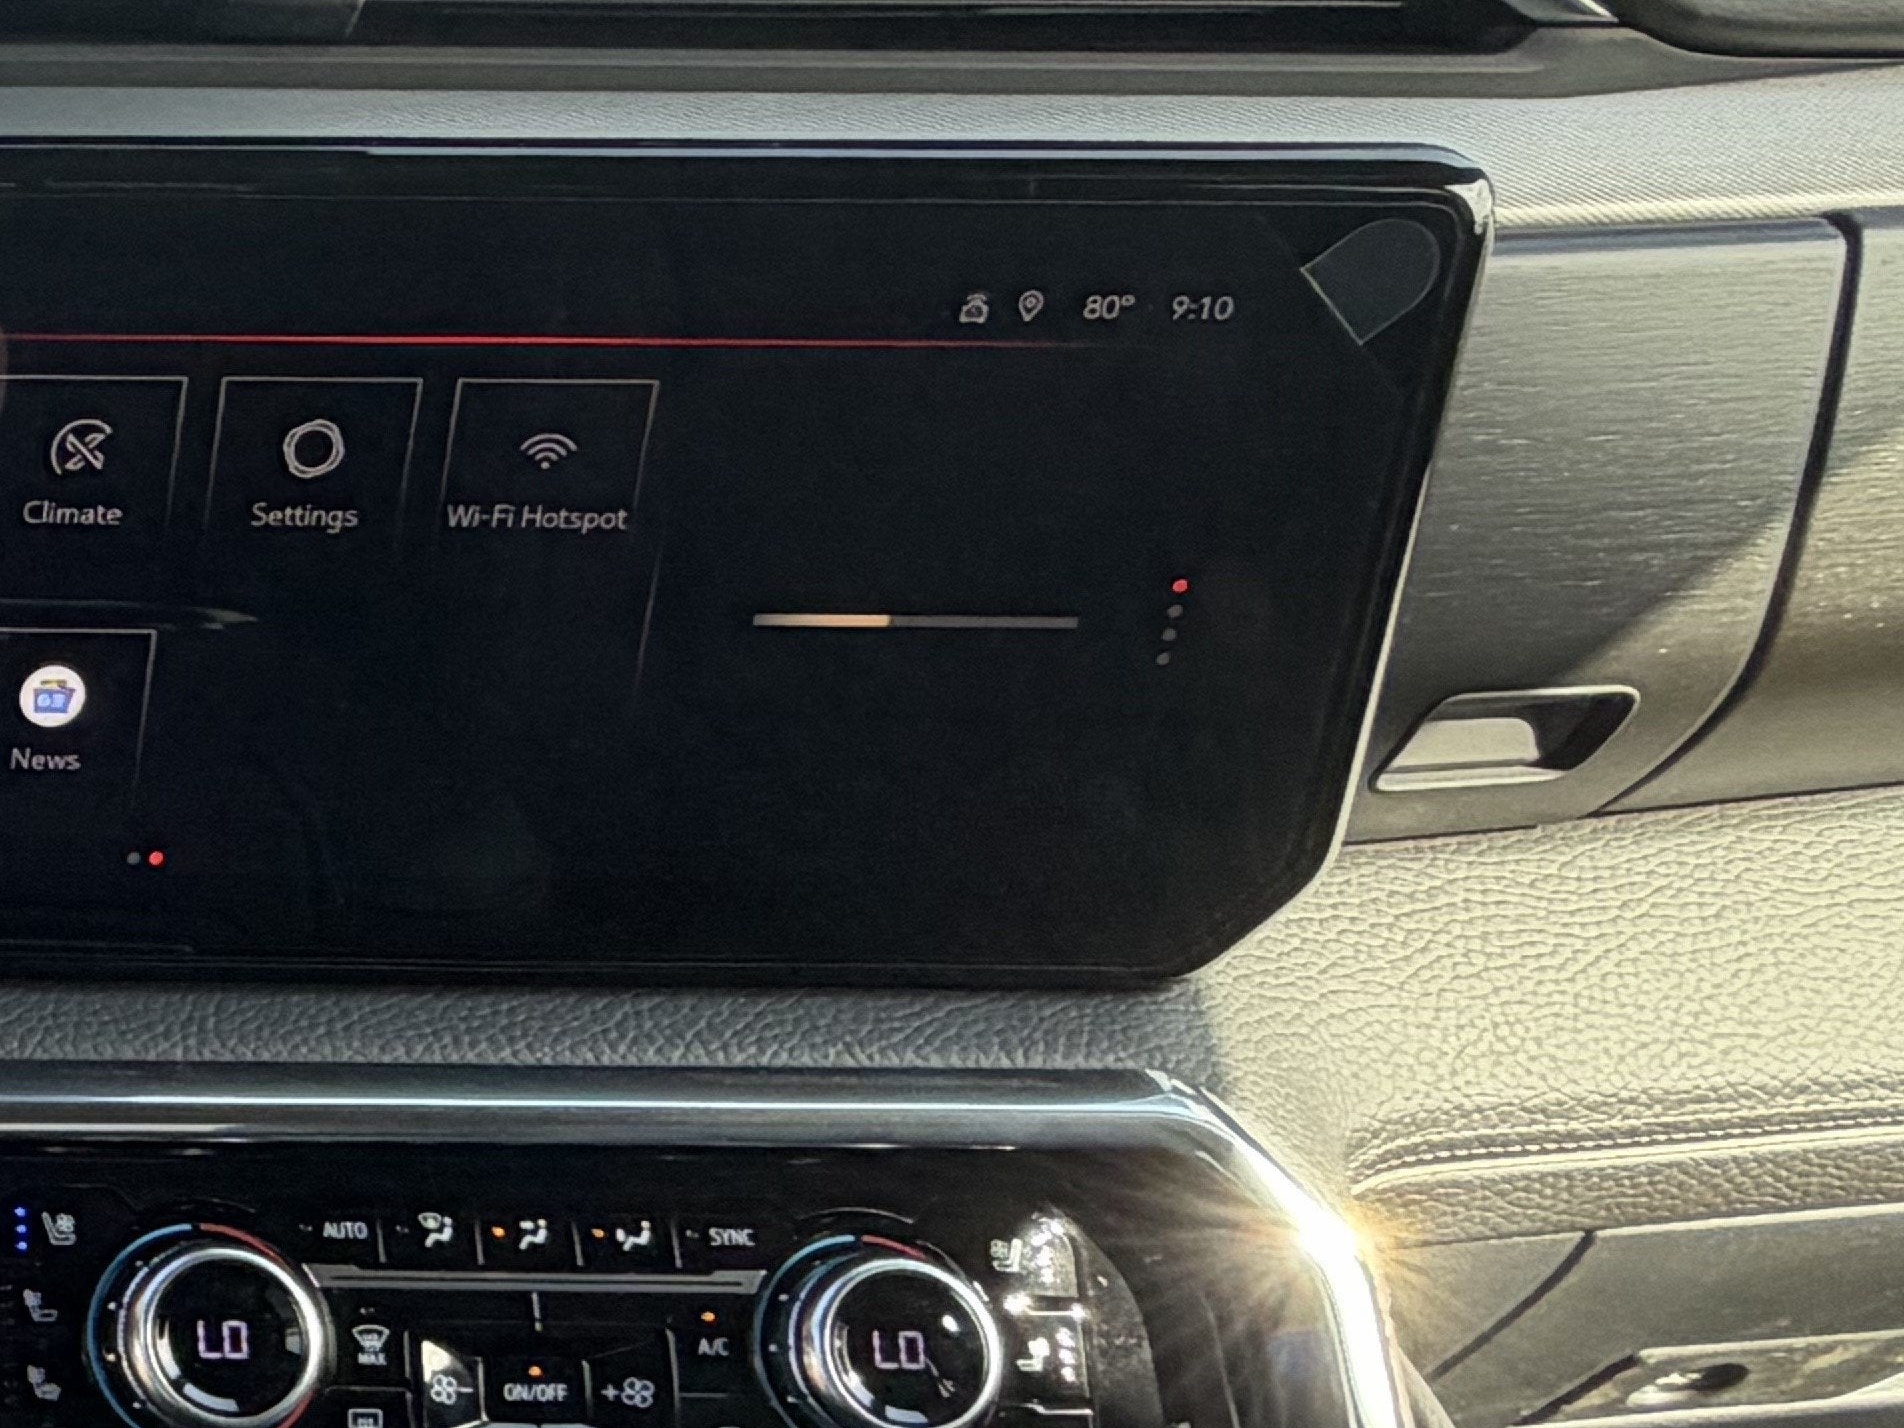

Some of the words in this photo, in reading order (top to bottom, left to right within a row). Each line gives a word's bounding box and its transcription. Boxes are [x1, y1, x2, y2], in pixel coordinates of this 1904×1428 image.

[1172, 295, 1234, 320] 9:10
[22, 500, 124, 526] Climate
[250, 502, 359, 534] Settings
[446, 503, 516, 529] Wi-Fi
[520, 504, 629, 534] Hotspot
[9, 747, 82, 772] News
[322, 1221, 368, 1240] AUTO
[708, 1228, 756, 1248] SYNC
[697, 1336, 730, 1357] A/C
[502, 1382, 569, 1403] ON/OFF
